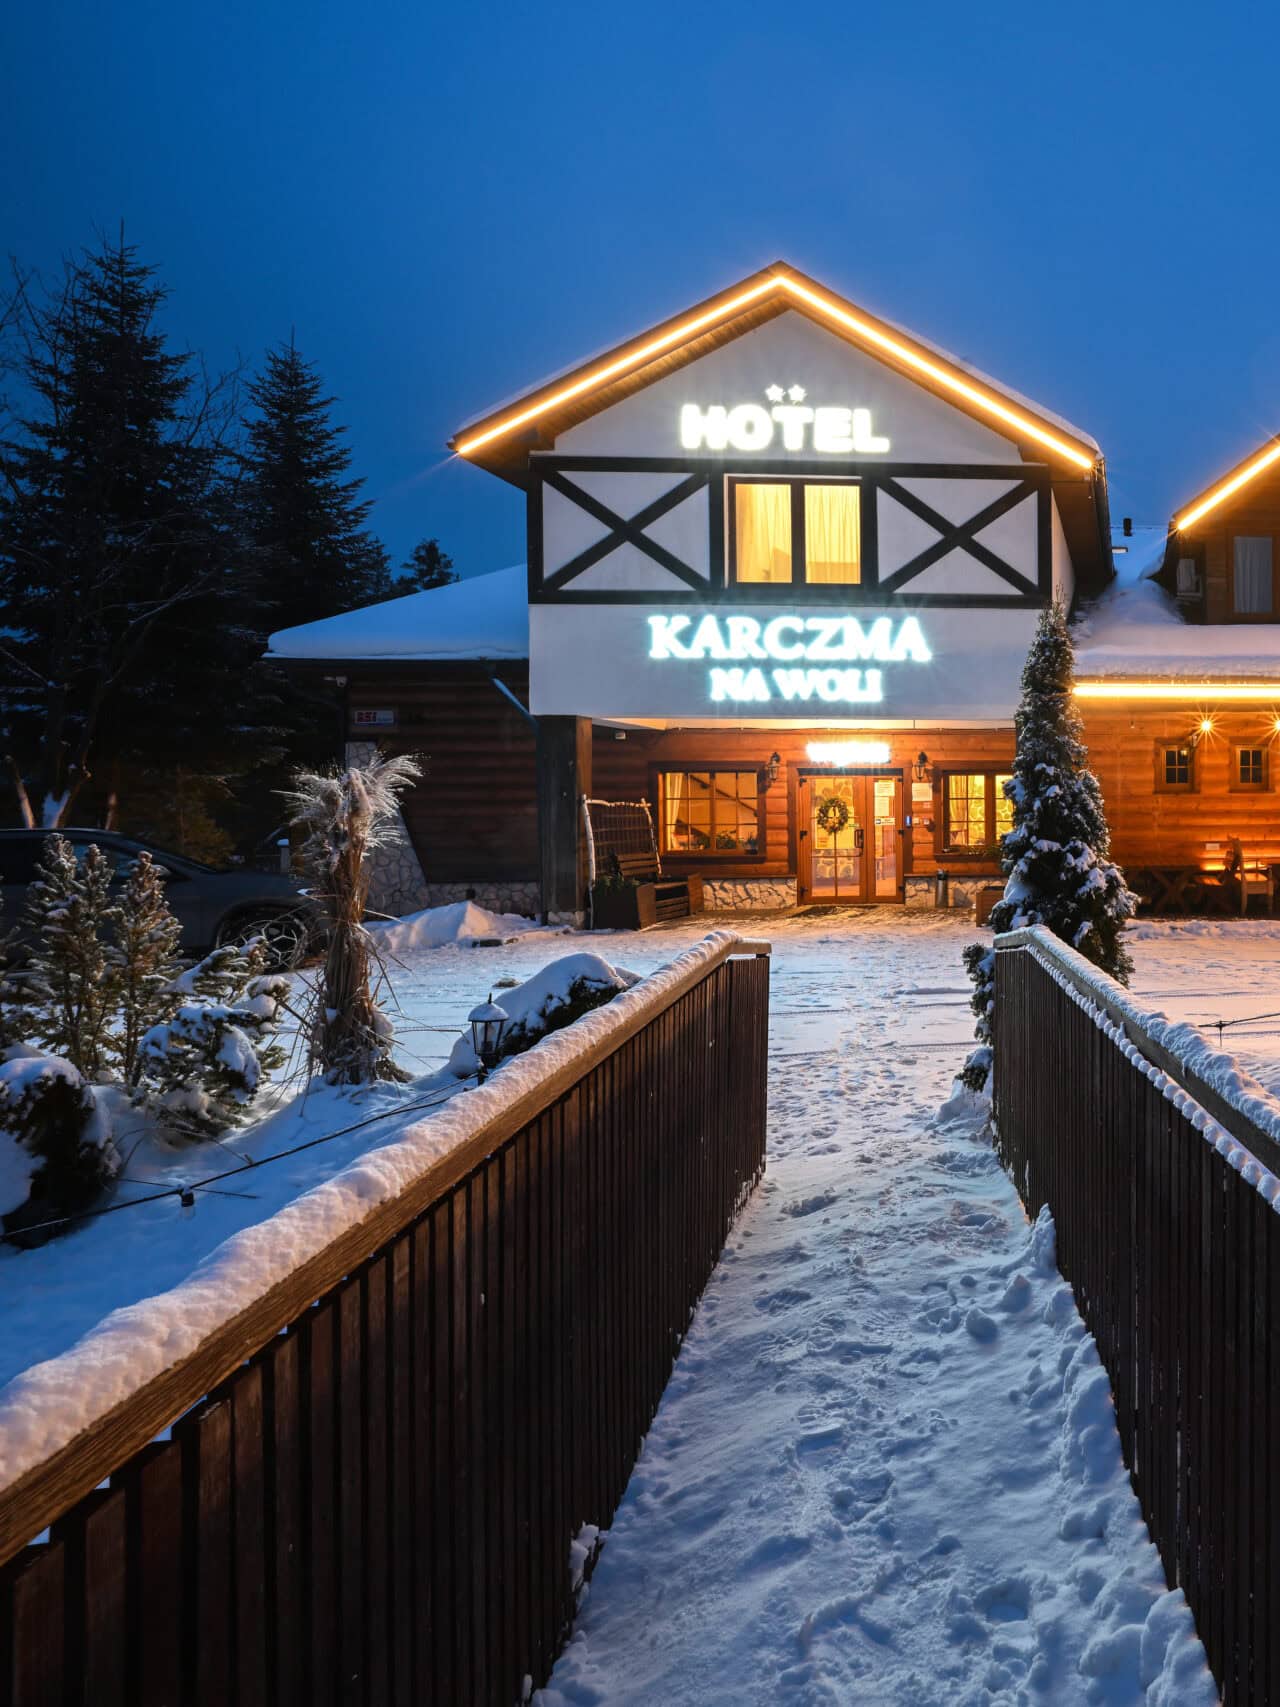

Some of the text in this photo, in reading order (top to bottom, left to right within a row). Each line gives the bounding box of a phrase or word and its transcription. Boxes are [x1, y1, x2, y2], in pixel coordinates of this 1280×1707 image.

[680, 404, 890, 453] HOTEL
[648, 615, 932, 662] KARCZMA
[710, 668, 770, 701] NA
